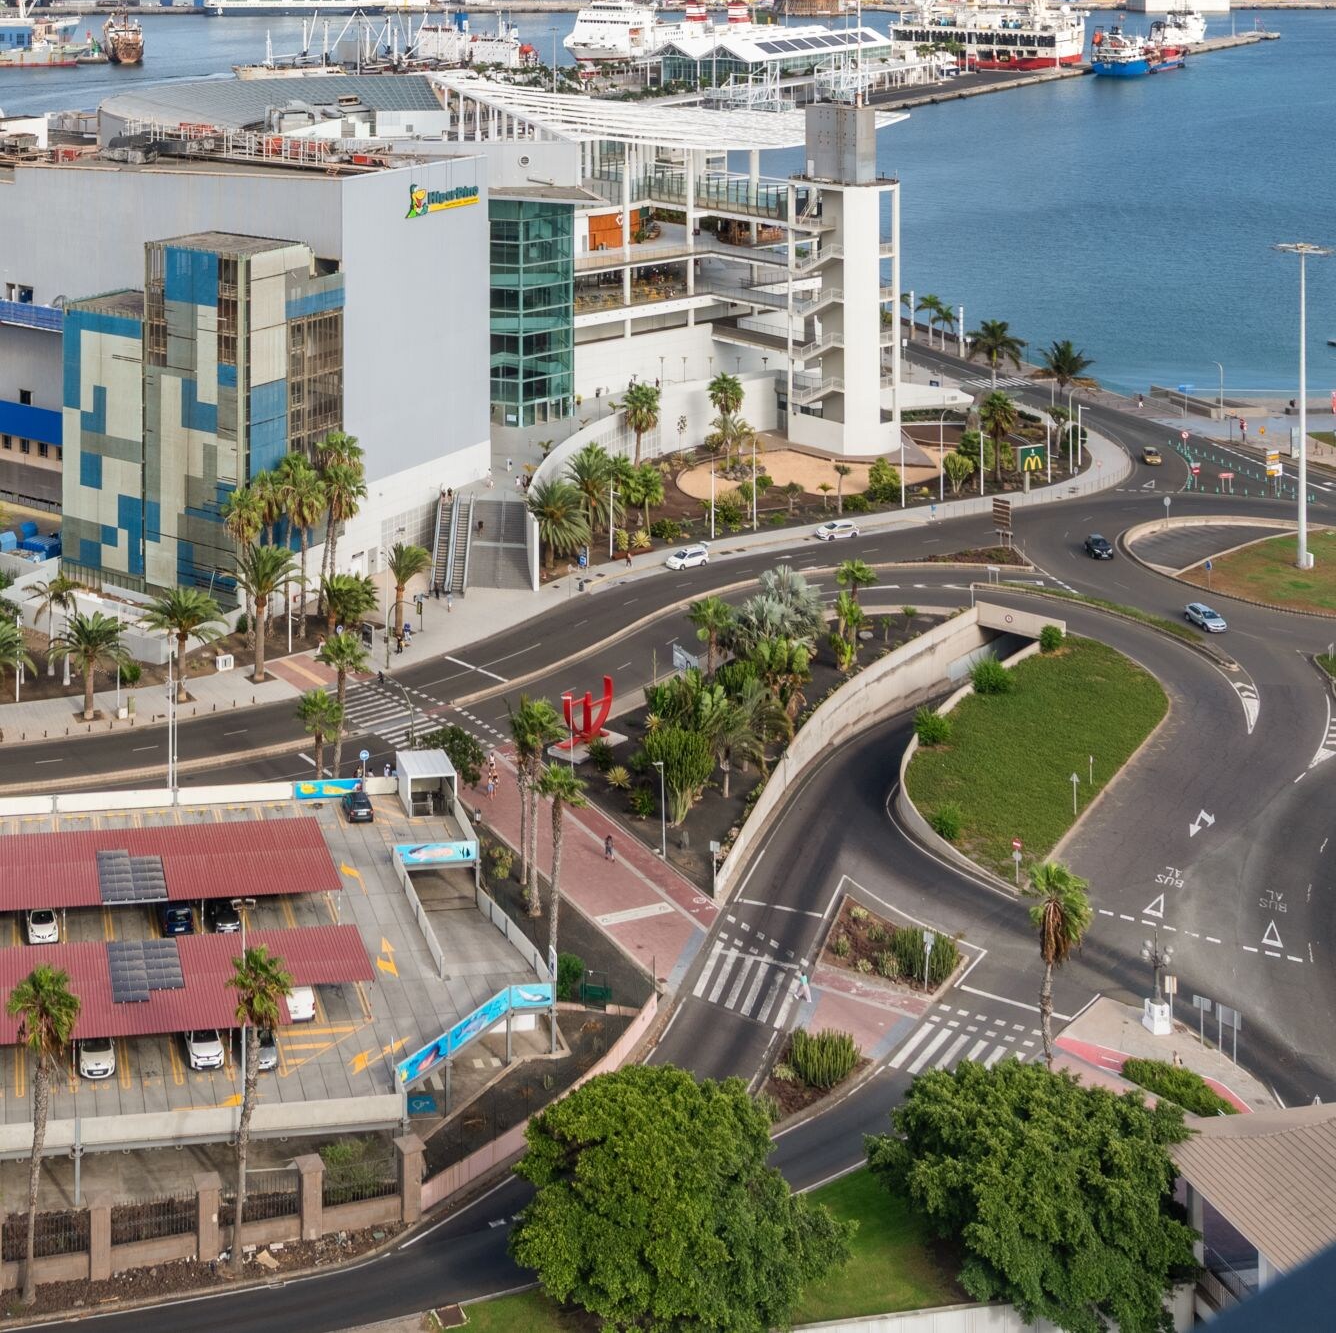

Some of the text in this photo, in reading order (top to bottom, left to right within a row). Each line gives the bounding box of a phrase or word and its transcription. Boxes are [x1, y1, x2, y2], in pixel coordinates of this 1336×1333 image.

[428, 186, 479, 204] HiperDino
[1154, 874, 1184, 888] BUS
[1266, 889, 1284, 901] AL
[1258, 898, 1288, 913] BUS
